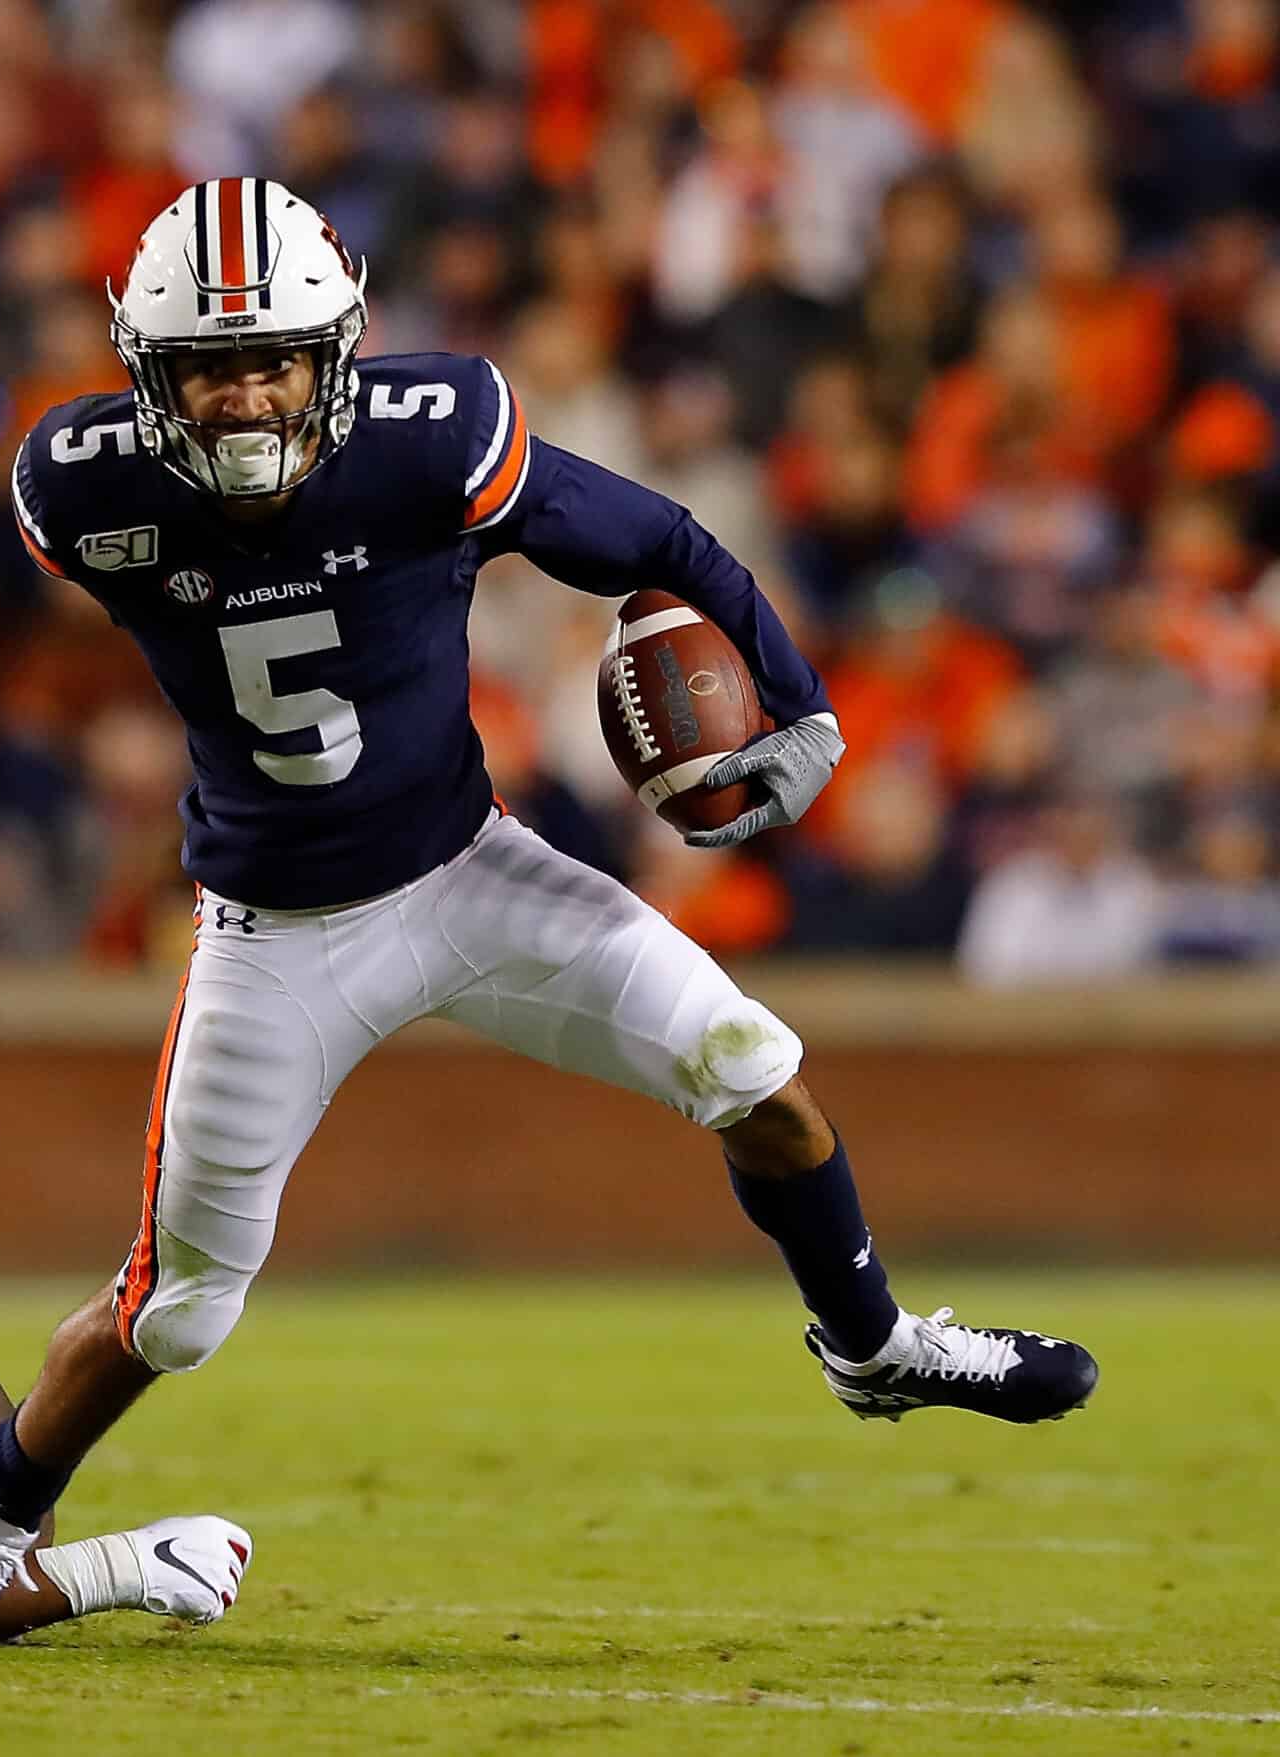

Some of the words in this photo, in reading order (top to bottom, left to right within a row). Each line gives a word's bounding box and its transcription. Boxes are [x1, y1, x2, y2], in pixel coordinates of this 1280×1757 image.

[369, 382, 456, 421] 5
[50, 423, 136, 465] 5
[75, 525, 158, 570] 150
[169, 570, 210, 603] SEC
[225, 580, 322, 609] AUBURN
[218, 610, 363, 786] 5
